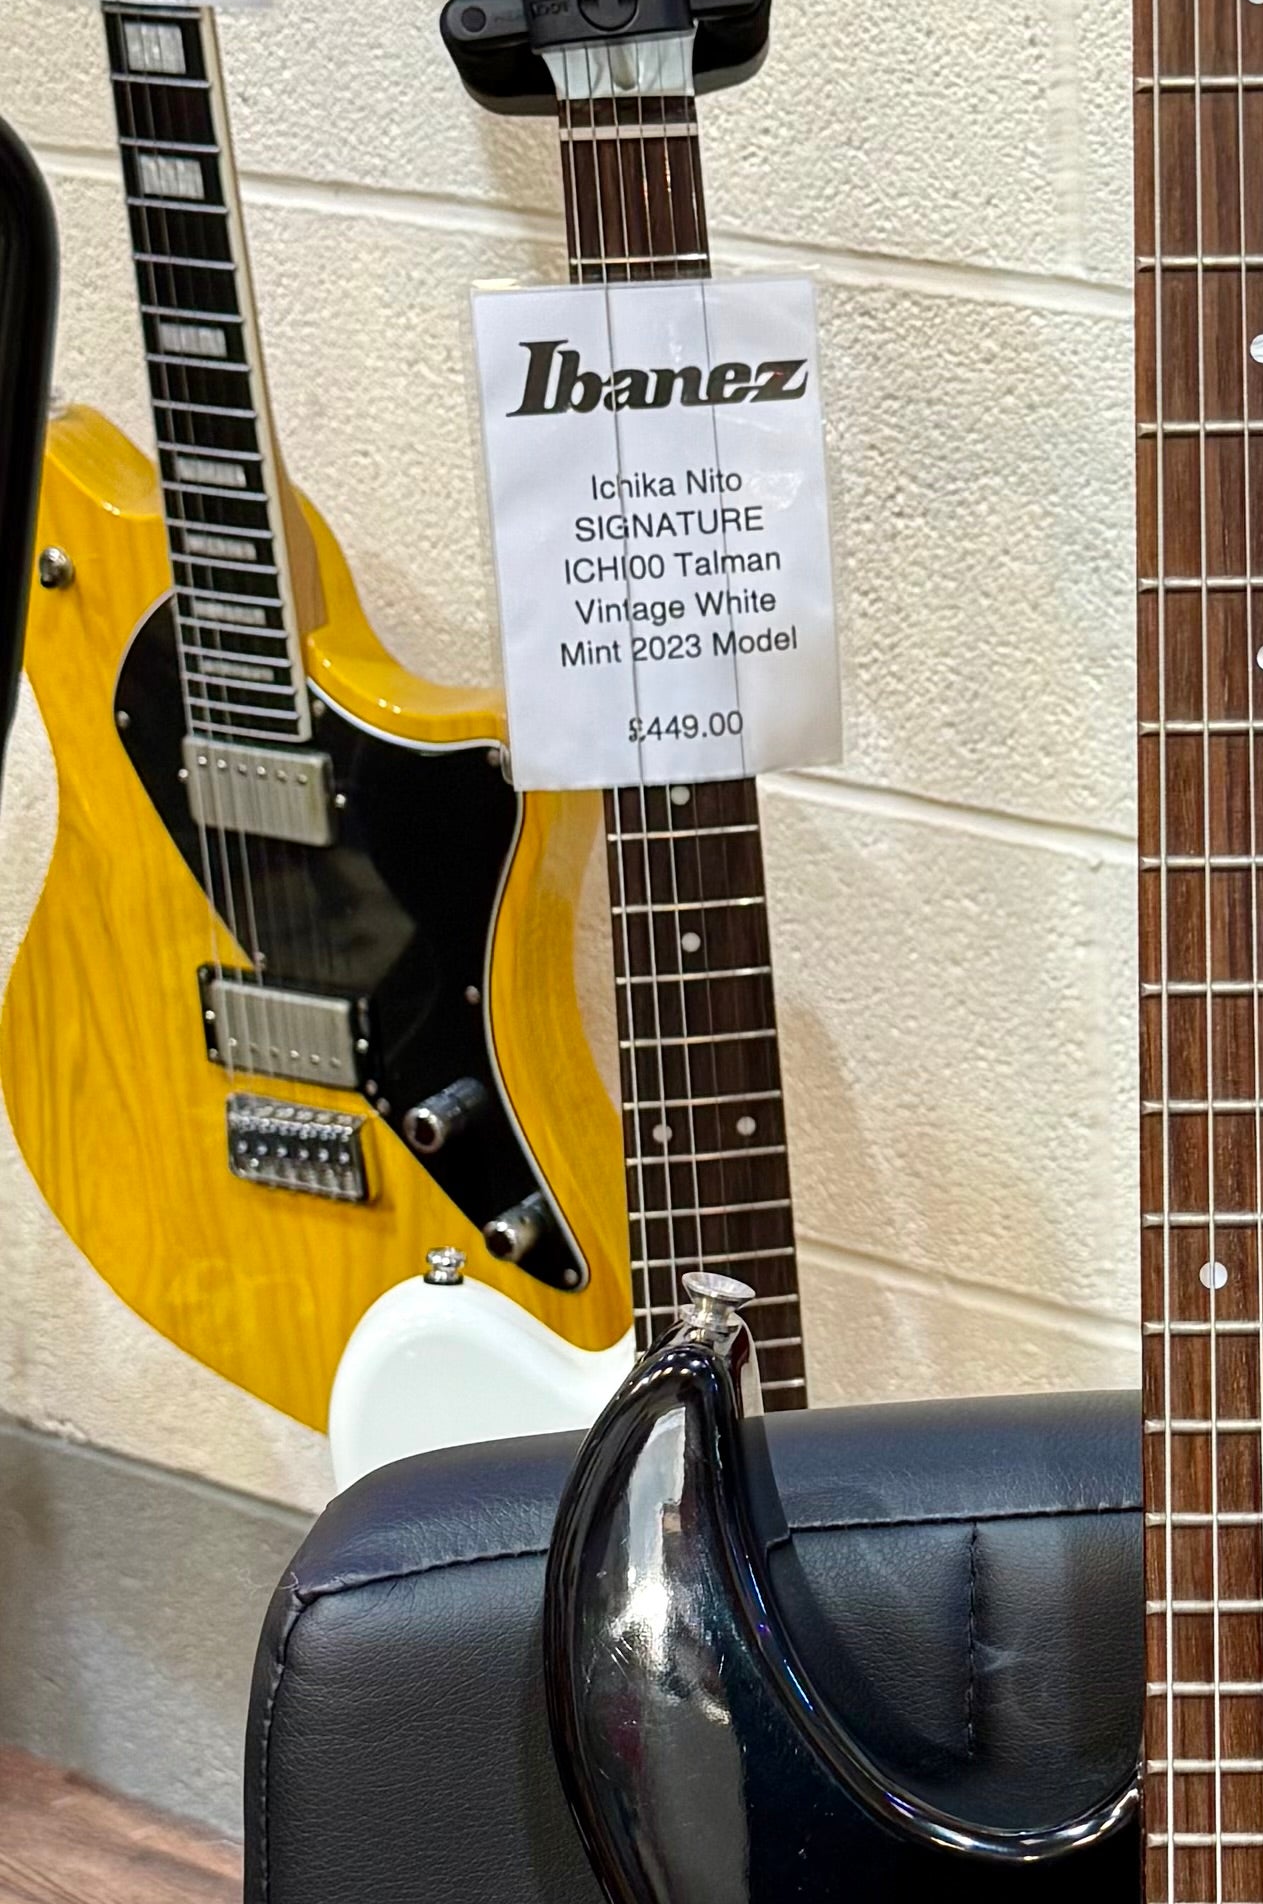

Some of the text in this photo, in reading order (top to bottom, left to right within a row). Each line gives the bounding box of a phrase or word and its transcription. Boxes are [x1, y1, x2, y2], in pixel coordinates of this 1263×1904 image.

[506, 339, 809, 418] Ibanez
[591, 469, 743, 501] Ichika Nito
[575, 505, 764, 542] SIGNATURE
[674, 549, 782, 580] Talman
[575, 589, 777, 629] Vintage White
[561, 624, 799, 668] Mint 2023 Model
